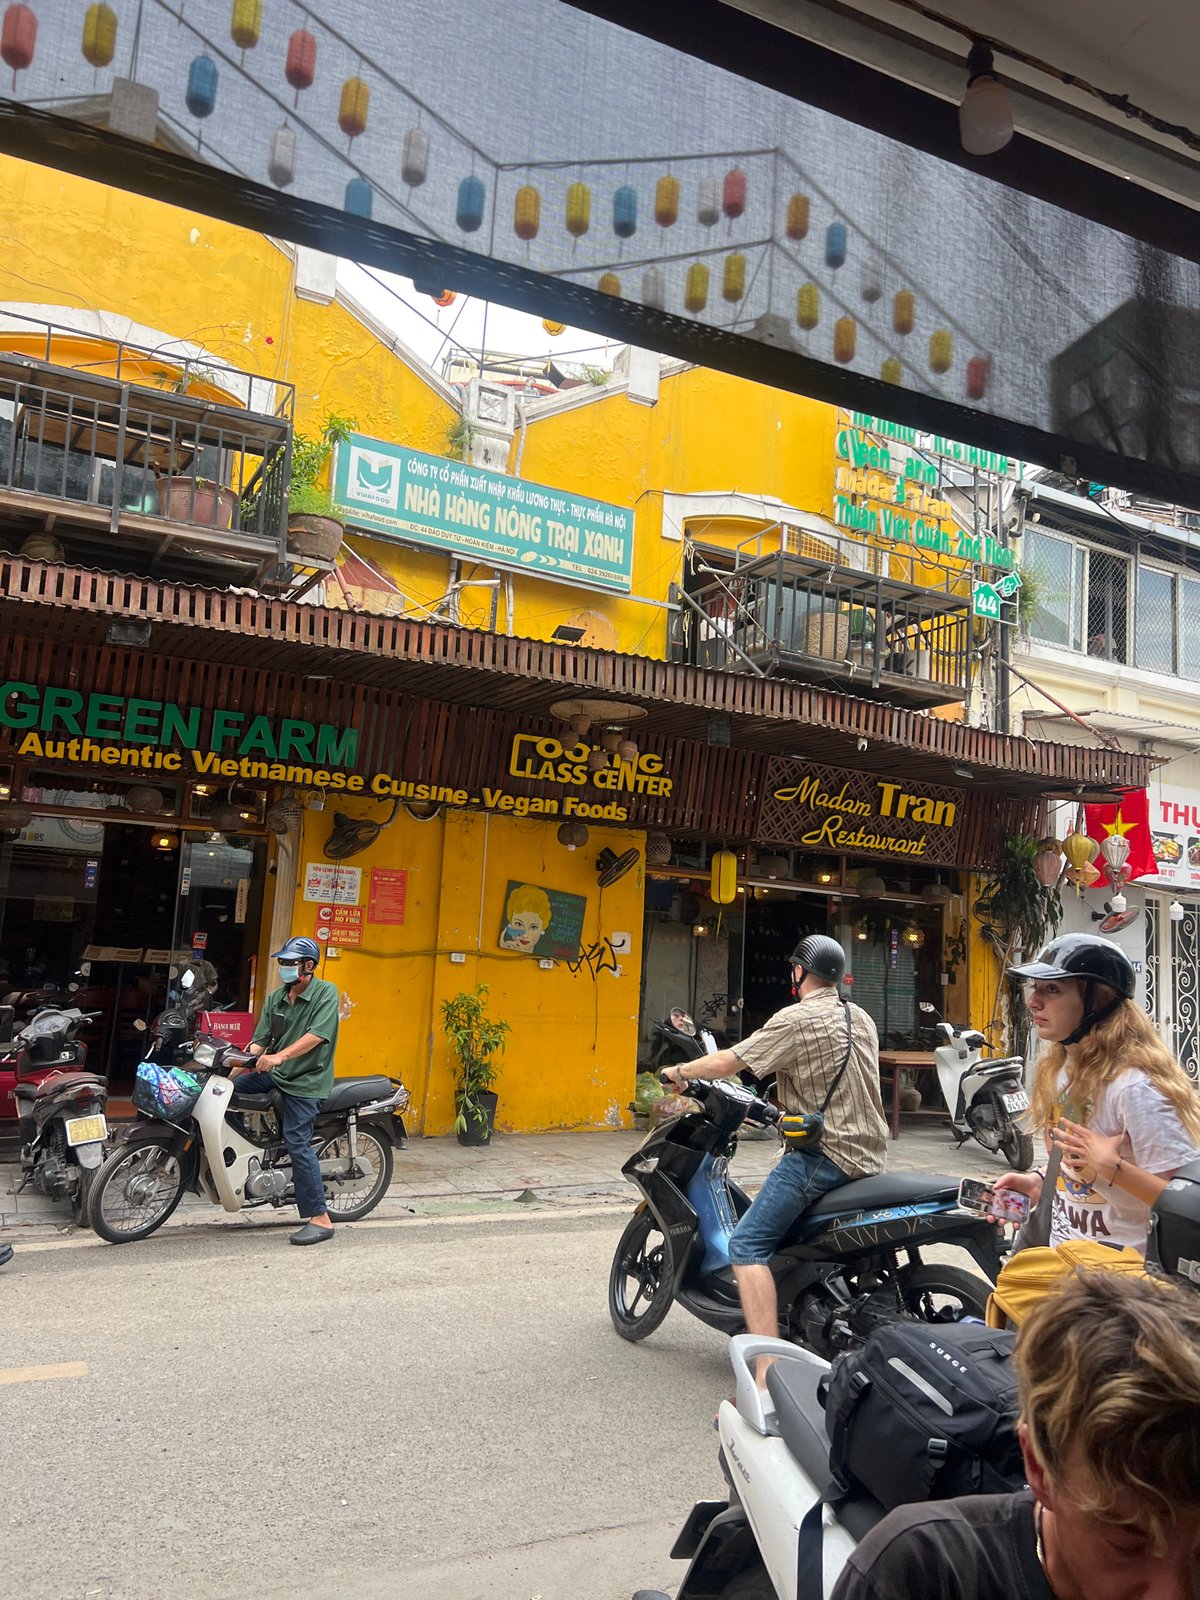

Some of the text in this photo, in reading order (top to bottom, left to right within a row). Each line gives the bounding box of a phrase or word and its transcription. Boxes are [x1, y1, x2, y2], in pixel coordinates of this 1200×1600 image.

[407, 457, 429, 477] CÔNG
[430, 465, 438, 479] TY
[439, 463, 450, 482] CỔ
[488, 480, 506, 500] NHẬP
[526, 491, 549, 509] LƯƠNG
[550, 498, 566, 516] THỰC
[570, 504, 586, 522] THỰC
[605, 512, 613, 526] HÀ
[614, 514, 626, 532] NỘI
[909, 487, 953, 519] Tran
[404, 483, 624, 564] NHÀ HÀNG NÔNG TRẠI XANH
[441, 531, 452, 540] DUY
[957, 530, 980, 560] 2nd
[571, 563, 583, 572] TEL
[977, 593, 997, 614] 44
[0, 681, 358, 768] GREEN FARM
[18, 732, 182, 771] Authentic
[192, 750, 364, 791] Vietnamese
[371, 773, 468, 806] Cuisine
[482, 787, 558, 816] Vegan
[564, 797, 628, 822] Foods
[593, 763, 673, 797] CENTER
[774, 775, 956, 827] Madam Tran
[801, 814, 927, 856] Restaurant
[230, 1022, 241, 1031] BEER
[898, 1205, 918, 1217] SX
[1055, 1194, 1111, 1236] AWA
[929, 1342, 968, 1373] SURGE
